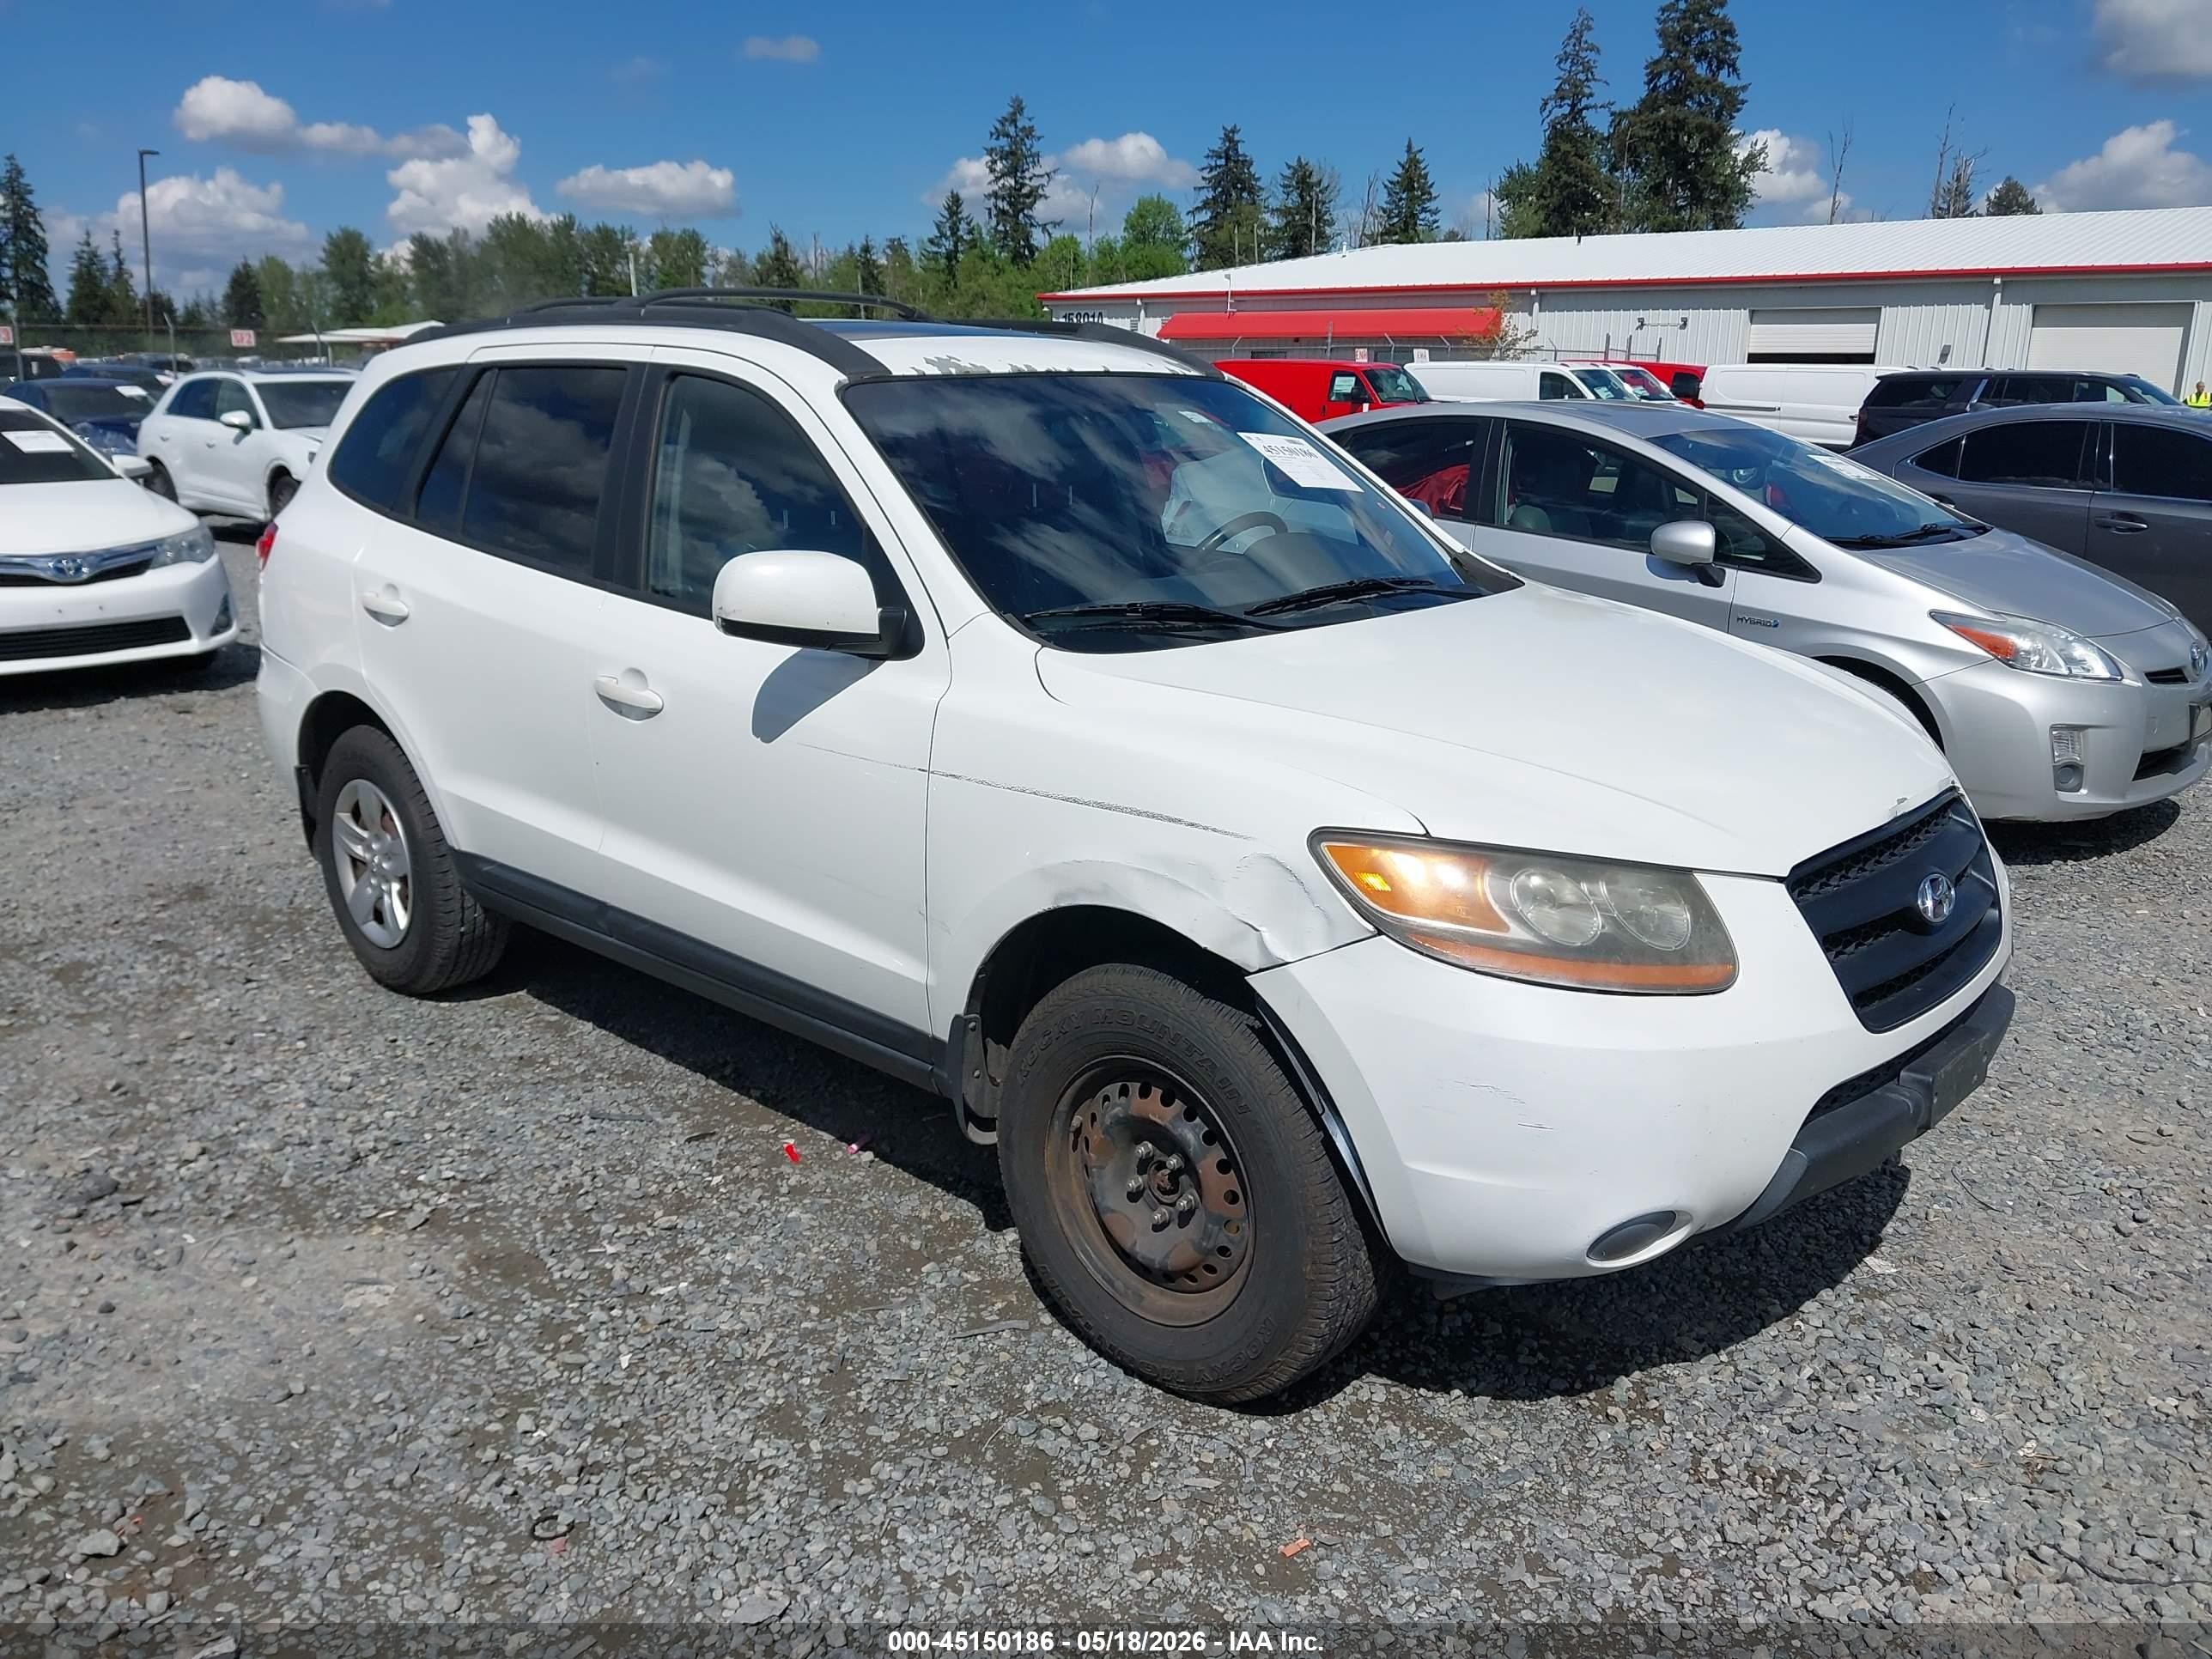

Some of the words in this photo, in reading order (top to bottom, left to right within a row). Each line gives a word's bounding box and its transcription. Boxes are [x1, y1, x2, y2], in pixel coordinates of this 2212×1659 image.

[1736, 616, 1772, 628] HYBRID
[1018, 1009, 1085, 1087] ROCKY
[1091, 1007, 1252, 1115] MOUNTAIN
